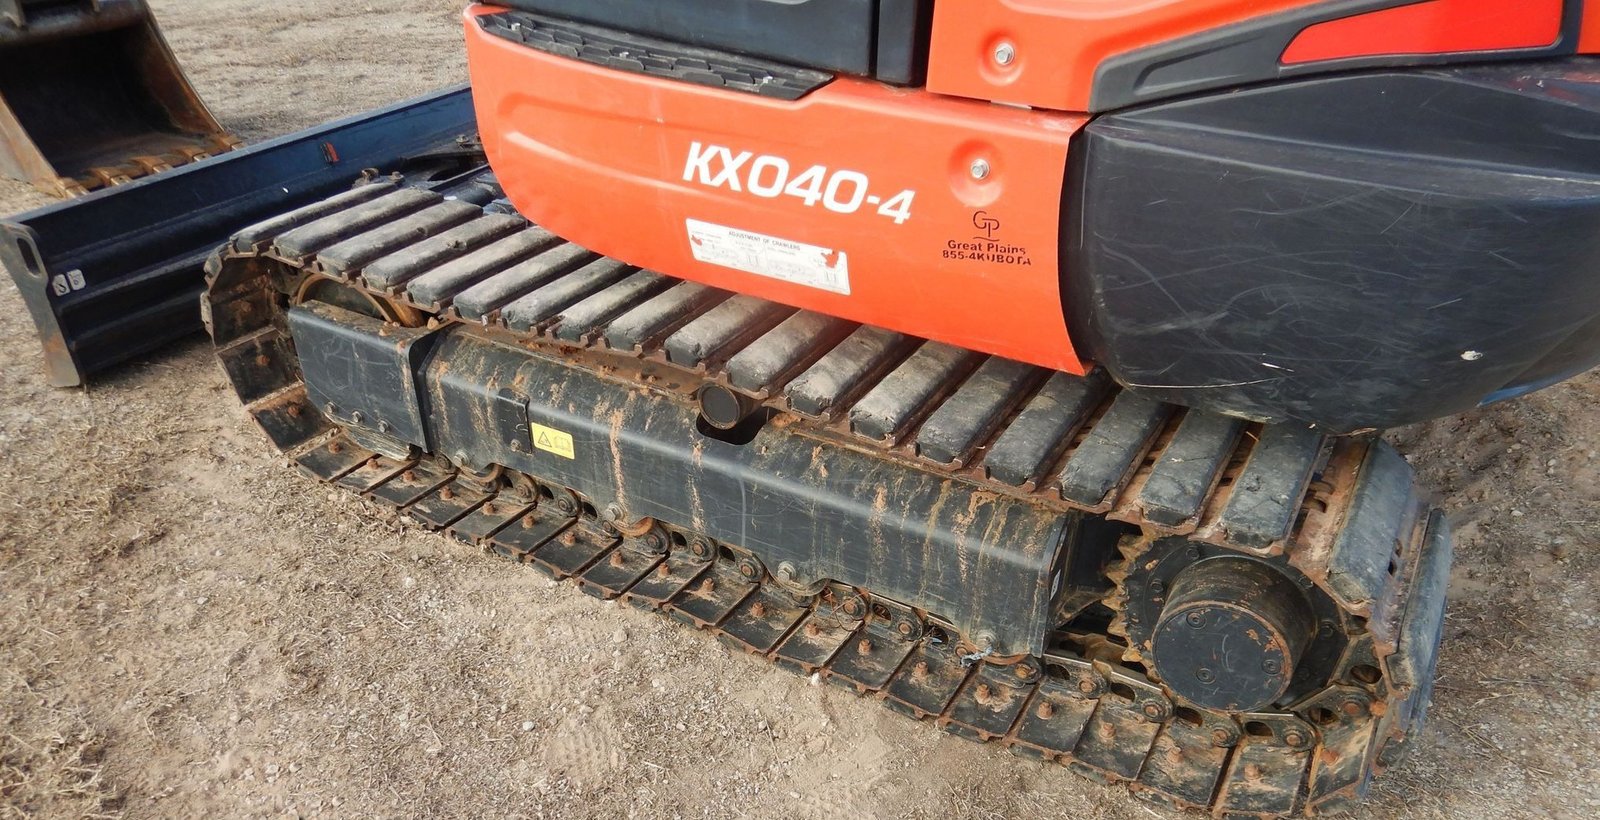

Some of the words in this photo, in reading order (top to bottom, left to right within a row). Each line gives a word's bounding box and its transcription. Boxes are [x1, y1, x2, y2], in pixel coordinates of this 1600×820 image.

[682, 141, 916, 224] KX040-4
[728, 231, 761, 242] ADJUSTMENT
[771, 240, 801, 251] CRAWLERS
[947, 239, 982, 252] Great
[987, 242, 1026, 255] Plains
